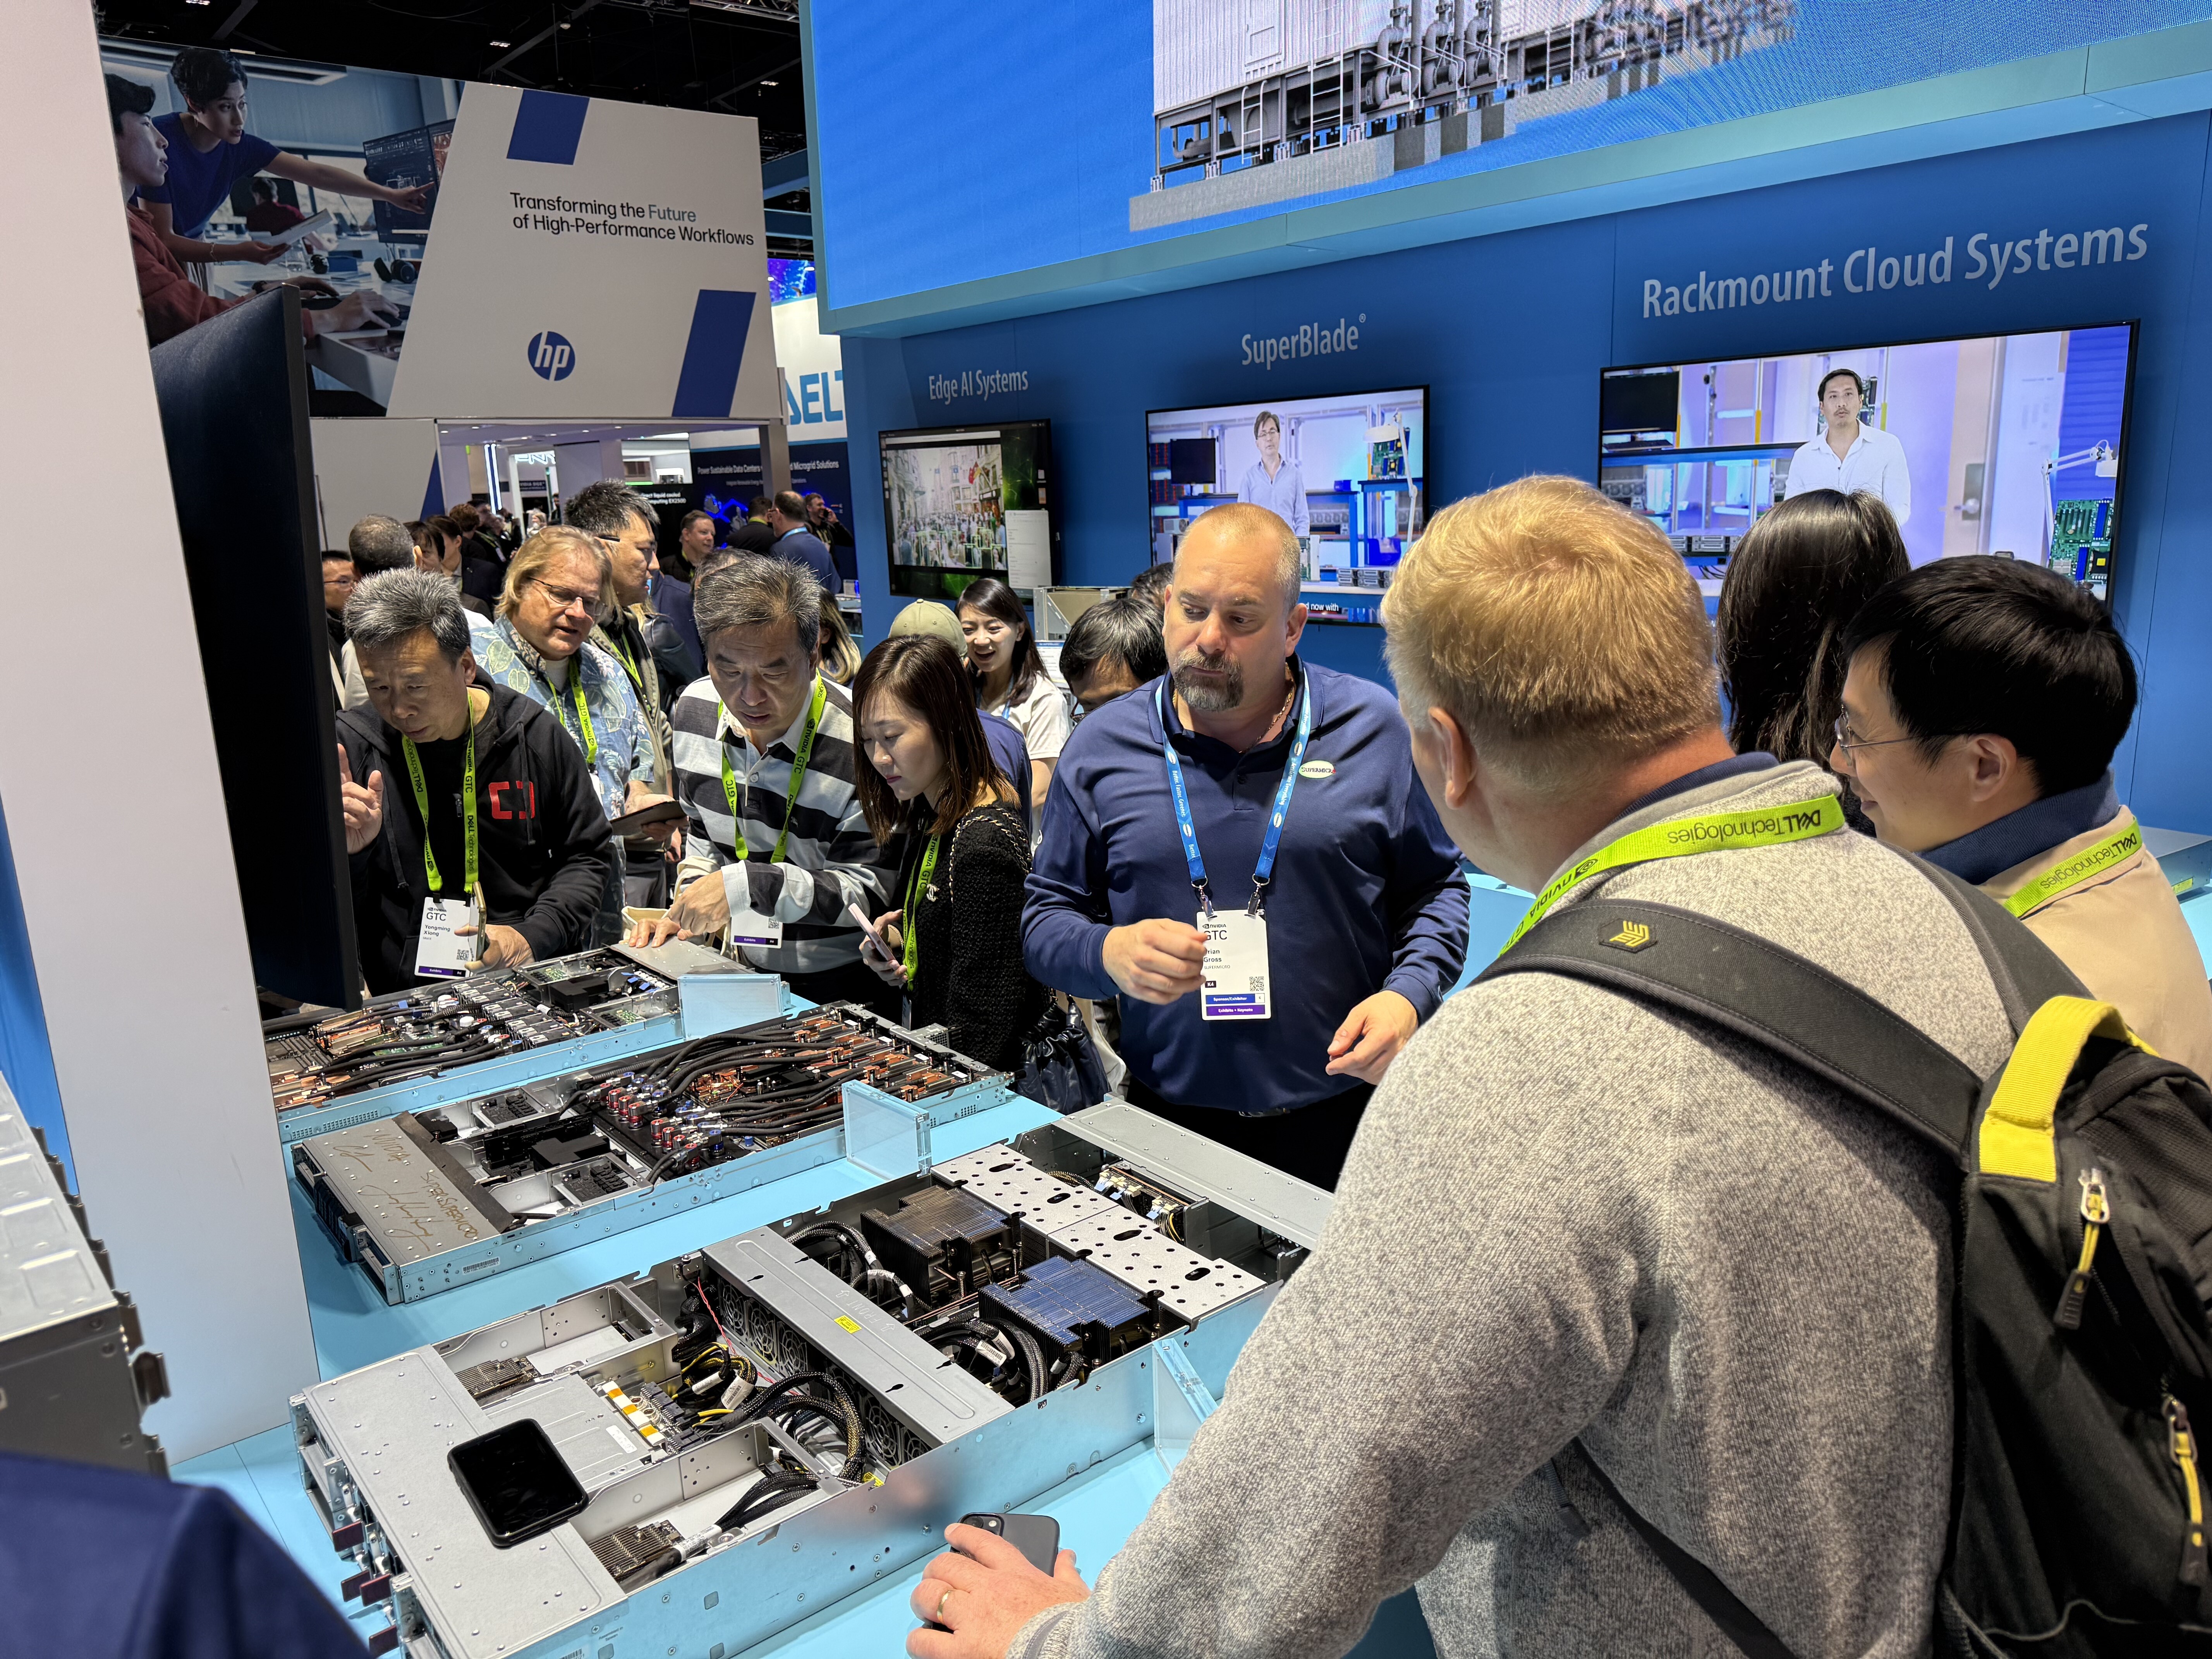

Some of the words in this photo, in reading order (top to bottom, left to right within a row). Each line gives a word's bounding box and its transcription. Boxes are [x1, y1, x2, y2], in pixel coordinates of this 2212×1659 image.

[510, 192, 617, 219] Transforming
[620, 202, 645, 218] the
[648, 204, 696, 222] Future
[513, 215, 530, 229] of
[534, 215, 676, 241] High-Performance
[679, 226, 754, 246] Workflows
[1643, 258, 1835, 319] Rackmount
[1843, 236, 1953, 294] Cloud
[1965, 223, 2148, 290] Systems
[534, 331, 571, 381] hp
[929, 375, 958, 405] Edge
[961, 371, 973, 397] AI
[976, 369, 1028, 402] Systems
[744, 464, 761, 472] Centers
[794, 460, 816, 472] Microgrid
[816, 460, 840, 469] Solutions
[1325, 603, 1339, 611] with
[579, 702, 587, 716] GTC
[583, 718, 592, 738] NVIDIA
[800, 728, 812, 753] NVIDIA
[794, 756, 805, 774] GTC
[726, 779, 735, 797] GTC
[926, 840, 938, 867] NVIDIA
[919, 870, 930, 889] GTC
[1530, 873, 1572, 918] NVIDIA
[426, 912, 447, 921] GTC
[846, 1300, 883, 1324] FRONT
